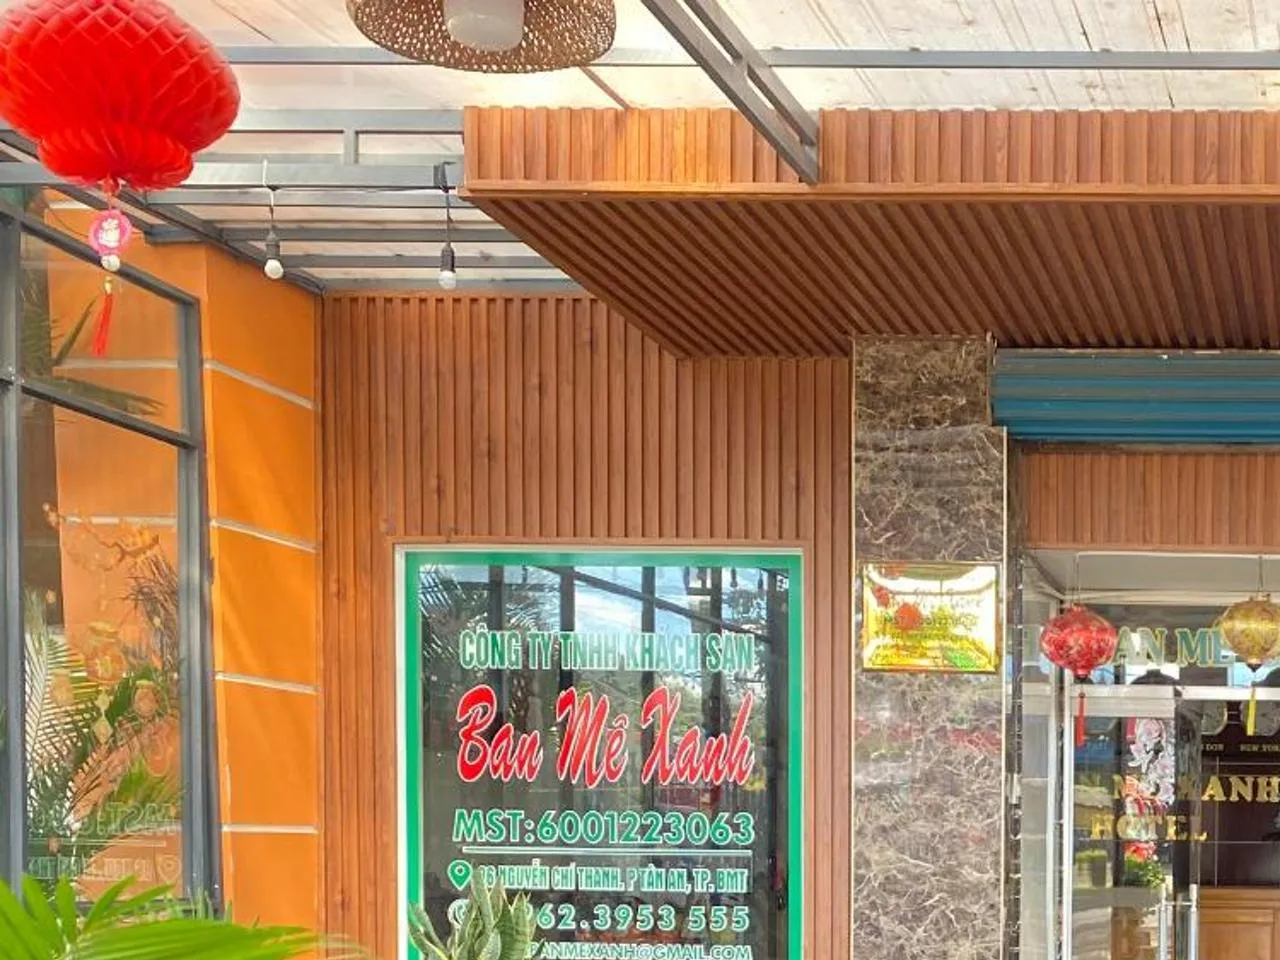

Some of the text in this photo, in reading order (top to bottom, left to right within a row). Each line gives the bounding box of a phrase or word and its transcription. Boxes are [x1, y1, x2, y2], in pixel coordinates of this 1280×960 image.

[460, 624, 521, 669] CÔNG
[527, 630, 551, 669] TY
[559, 631, 619, 671] TNHH
[1110, 626, 1166, 666] AN
[457, 684, 755, 788] Ban Mê Xanh
[452, 809, 755, 845] MST:6001223063
[552, 862, 576, 891] CHÍ
[667, 868, 692, 895] AN,
[526, 903, 750, 932] 62.3953 555
